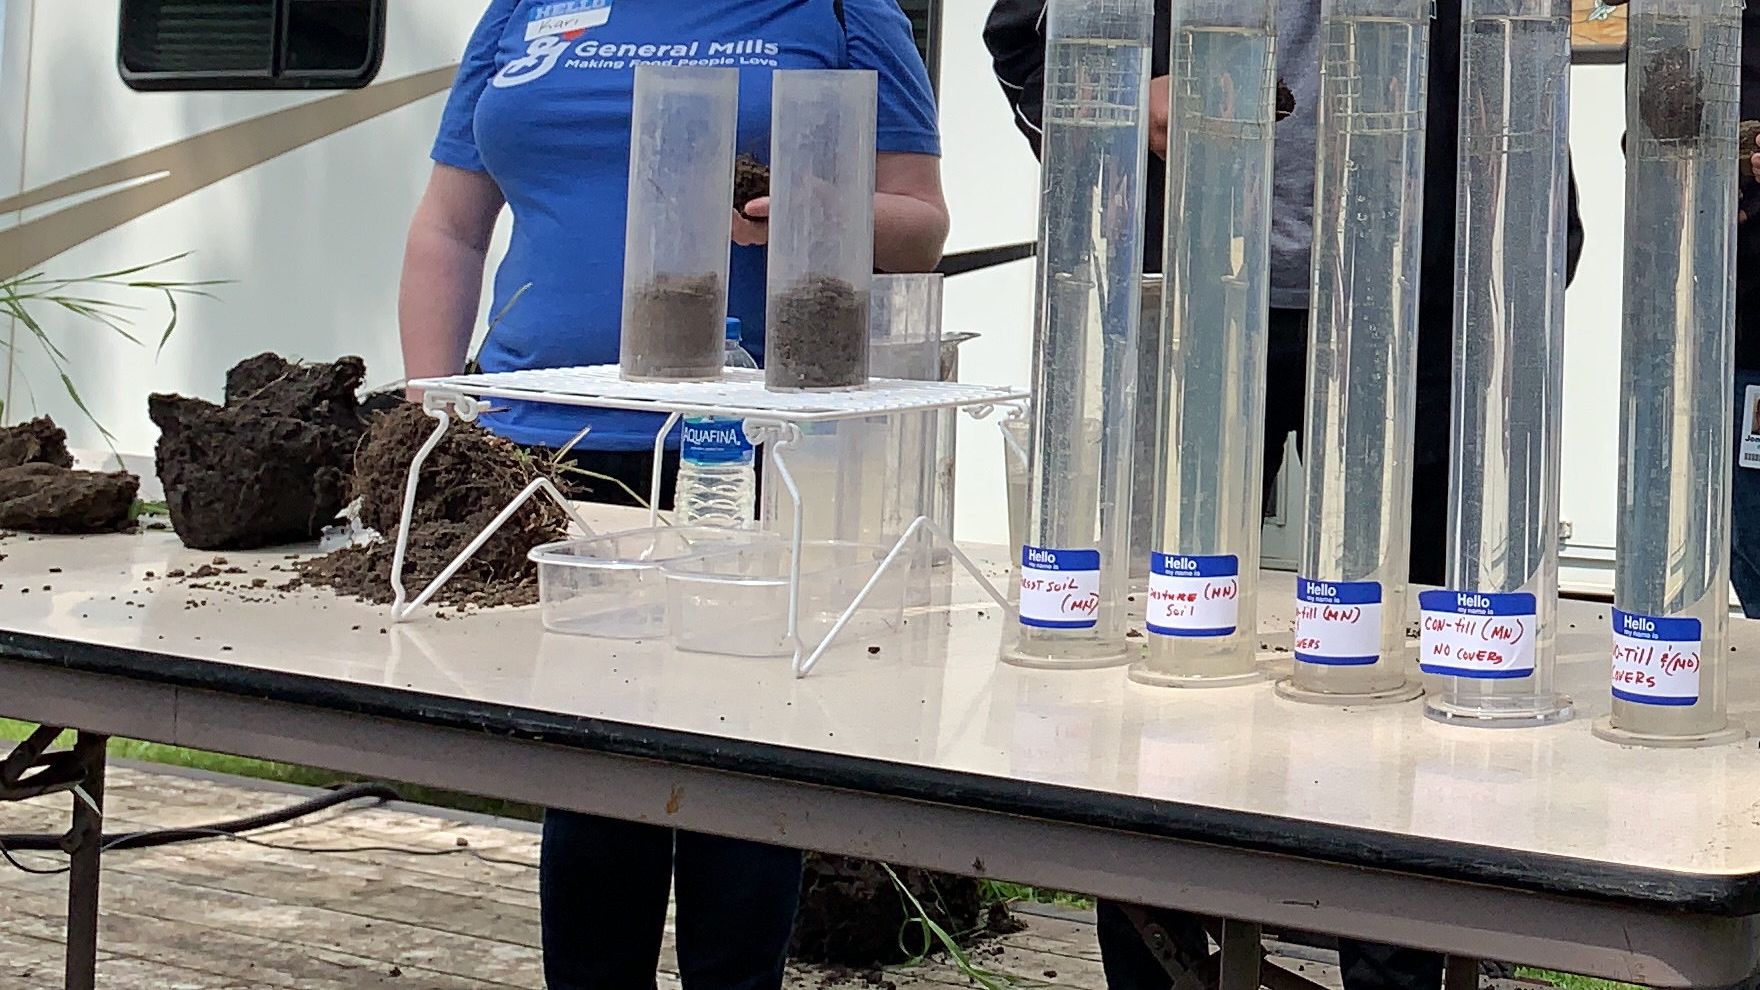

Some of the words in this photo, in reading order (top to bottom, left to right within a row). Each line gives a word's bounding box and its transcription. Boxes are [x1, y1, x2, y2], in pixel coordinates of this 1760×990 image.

[575, 40, 699, 58] General
[708, 39, 779, 56] Mills
[565, 59, 625, 69] Making
[677, 57, 735, 67] People
[740, 56, 778, 67] Love
[683, 427, 738, 445] AQUAFINA
[1028, 548, 1056, 563] Hello
[1165, 556, 1197, 570] Hello
[1307, 582, 1337, 596] Hello
[1457, 593, 1491, 608] Hello
[1624, 615, 1656, 631] Hello
[1433, 643, 1451, 657] NO
